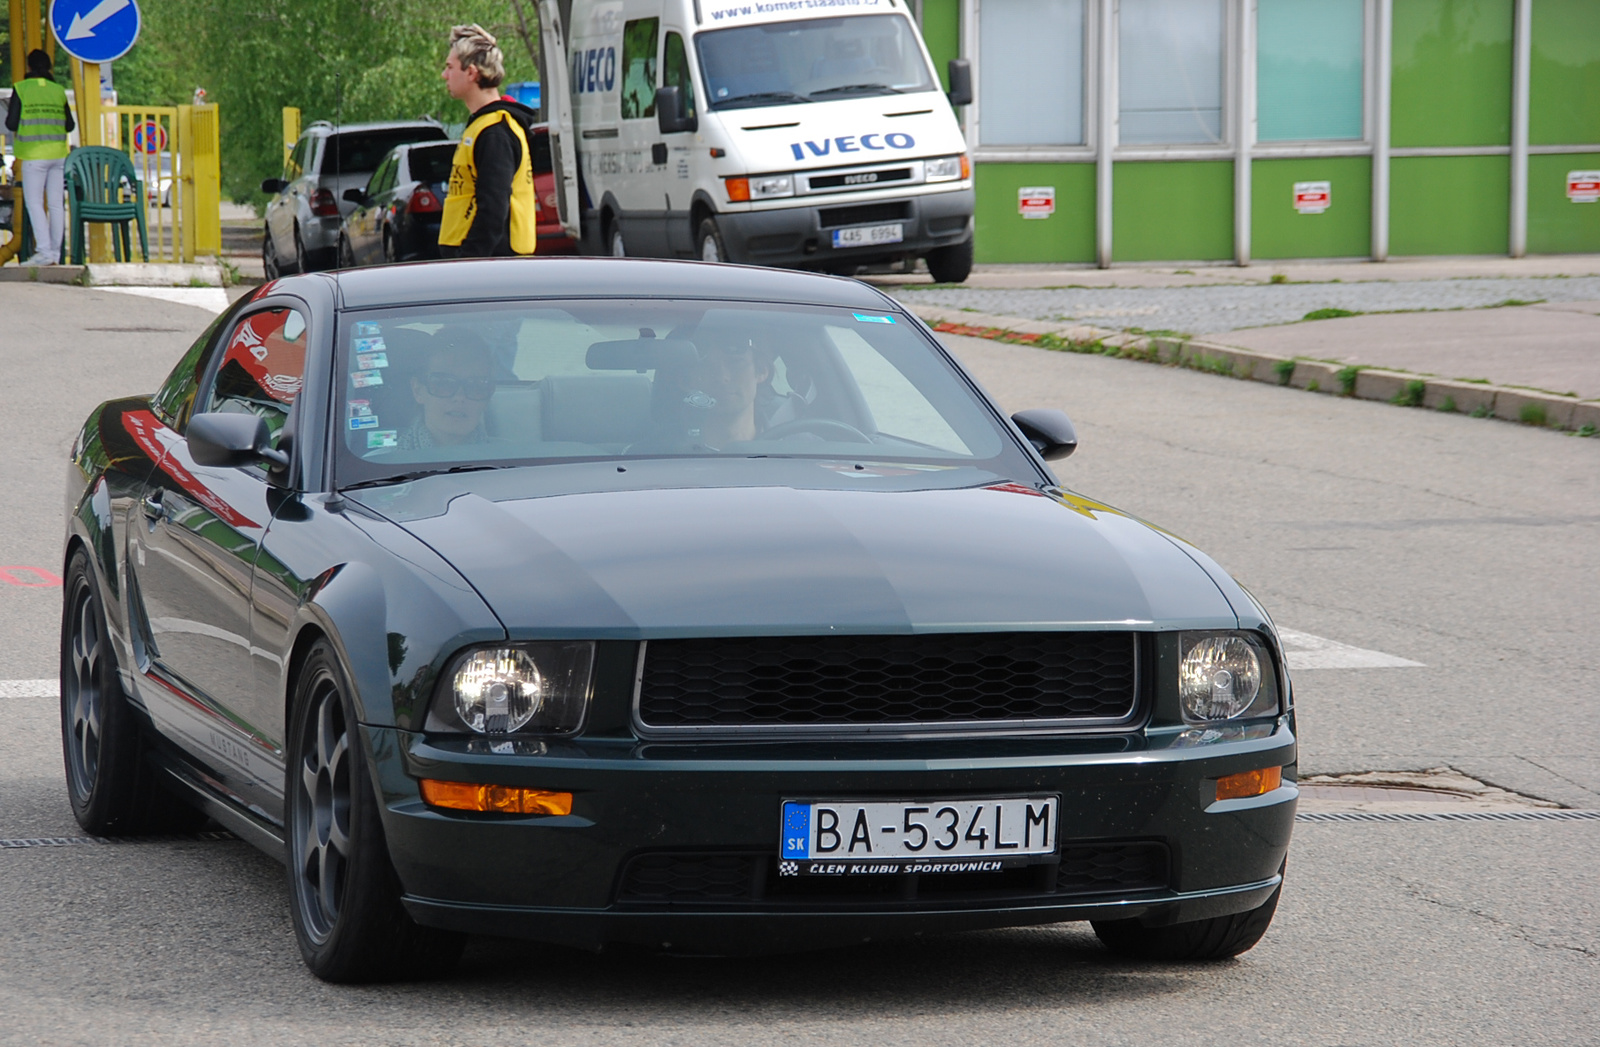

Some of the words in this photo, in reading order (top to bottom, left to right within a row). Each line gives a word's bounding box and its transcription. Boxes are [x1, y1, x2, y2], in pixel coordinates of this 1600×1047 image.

[573, 46, 615, 93] IVECO
[790, 133, 915, 161] IVECO
[844, 173, 878, 185] IVECO
[816, 803, 1050, 853] BA-534LM
[788, 838, 804, 850] SK
[850, 864, 899, 874] KLUBU
